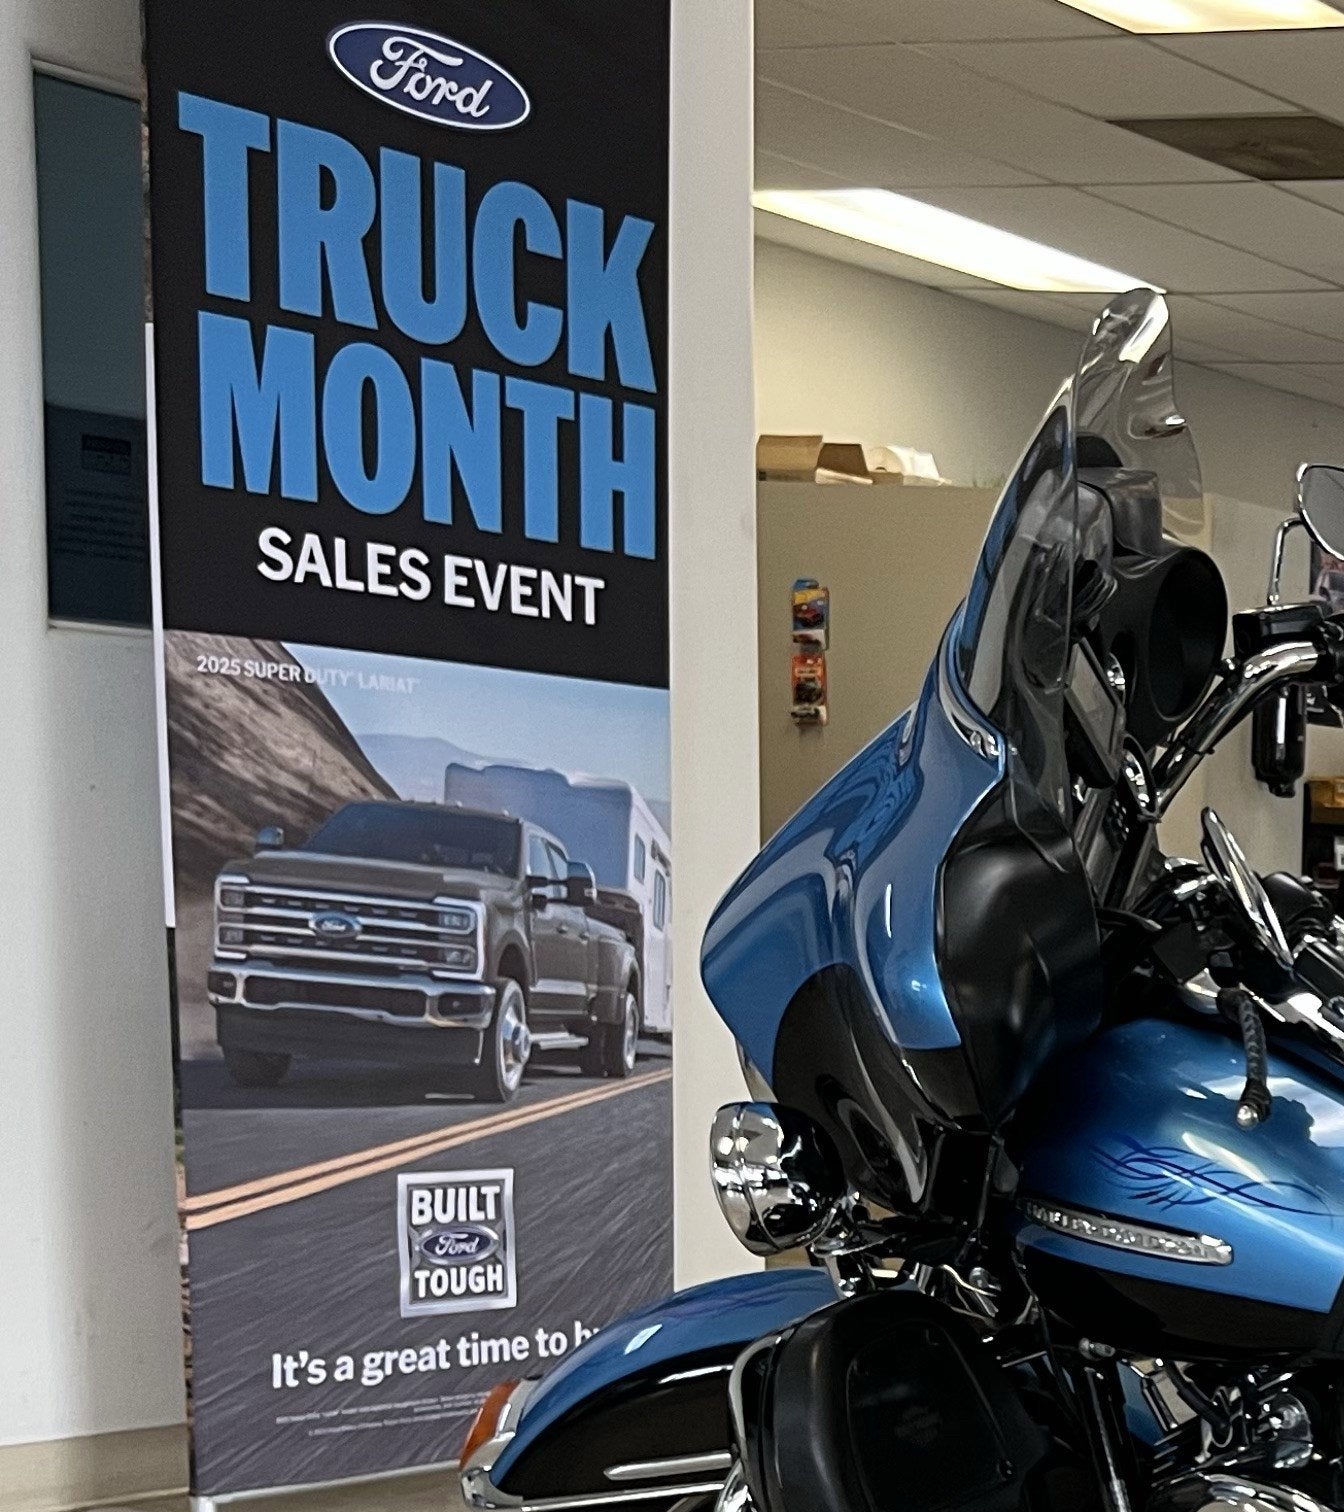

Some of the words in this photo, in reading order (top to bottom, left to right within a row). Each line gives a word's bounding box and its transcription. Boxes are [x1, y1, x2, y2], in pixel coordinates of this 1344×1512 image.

[370, 36, 492, 118] Ford
[178, 91, 657, 393] TRUCK
[198, 310, 656, 560] MONTH
[257, 526, 432, 601] SALES
[444, 554, 605, 626] EVENT
[196, 655, 241, 677] 2025
[243, 660, 301, 683] SUPER
[411, 1185, 501, 1226] BUILT
[435, 1232, 480, 1256] Ford
[414, 1263, 503, 1298] TOUGH
[272, 1350, 328, 1389] It's
[333, 1354, 354, 1382] a
[360, 1338, 451, 1387] great
[456, 1331, 530, 1367] time
[535, 1327, 568, 1358] to
